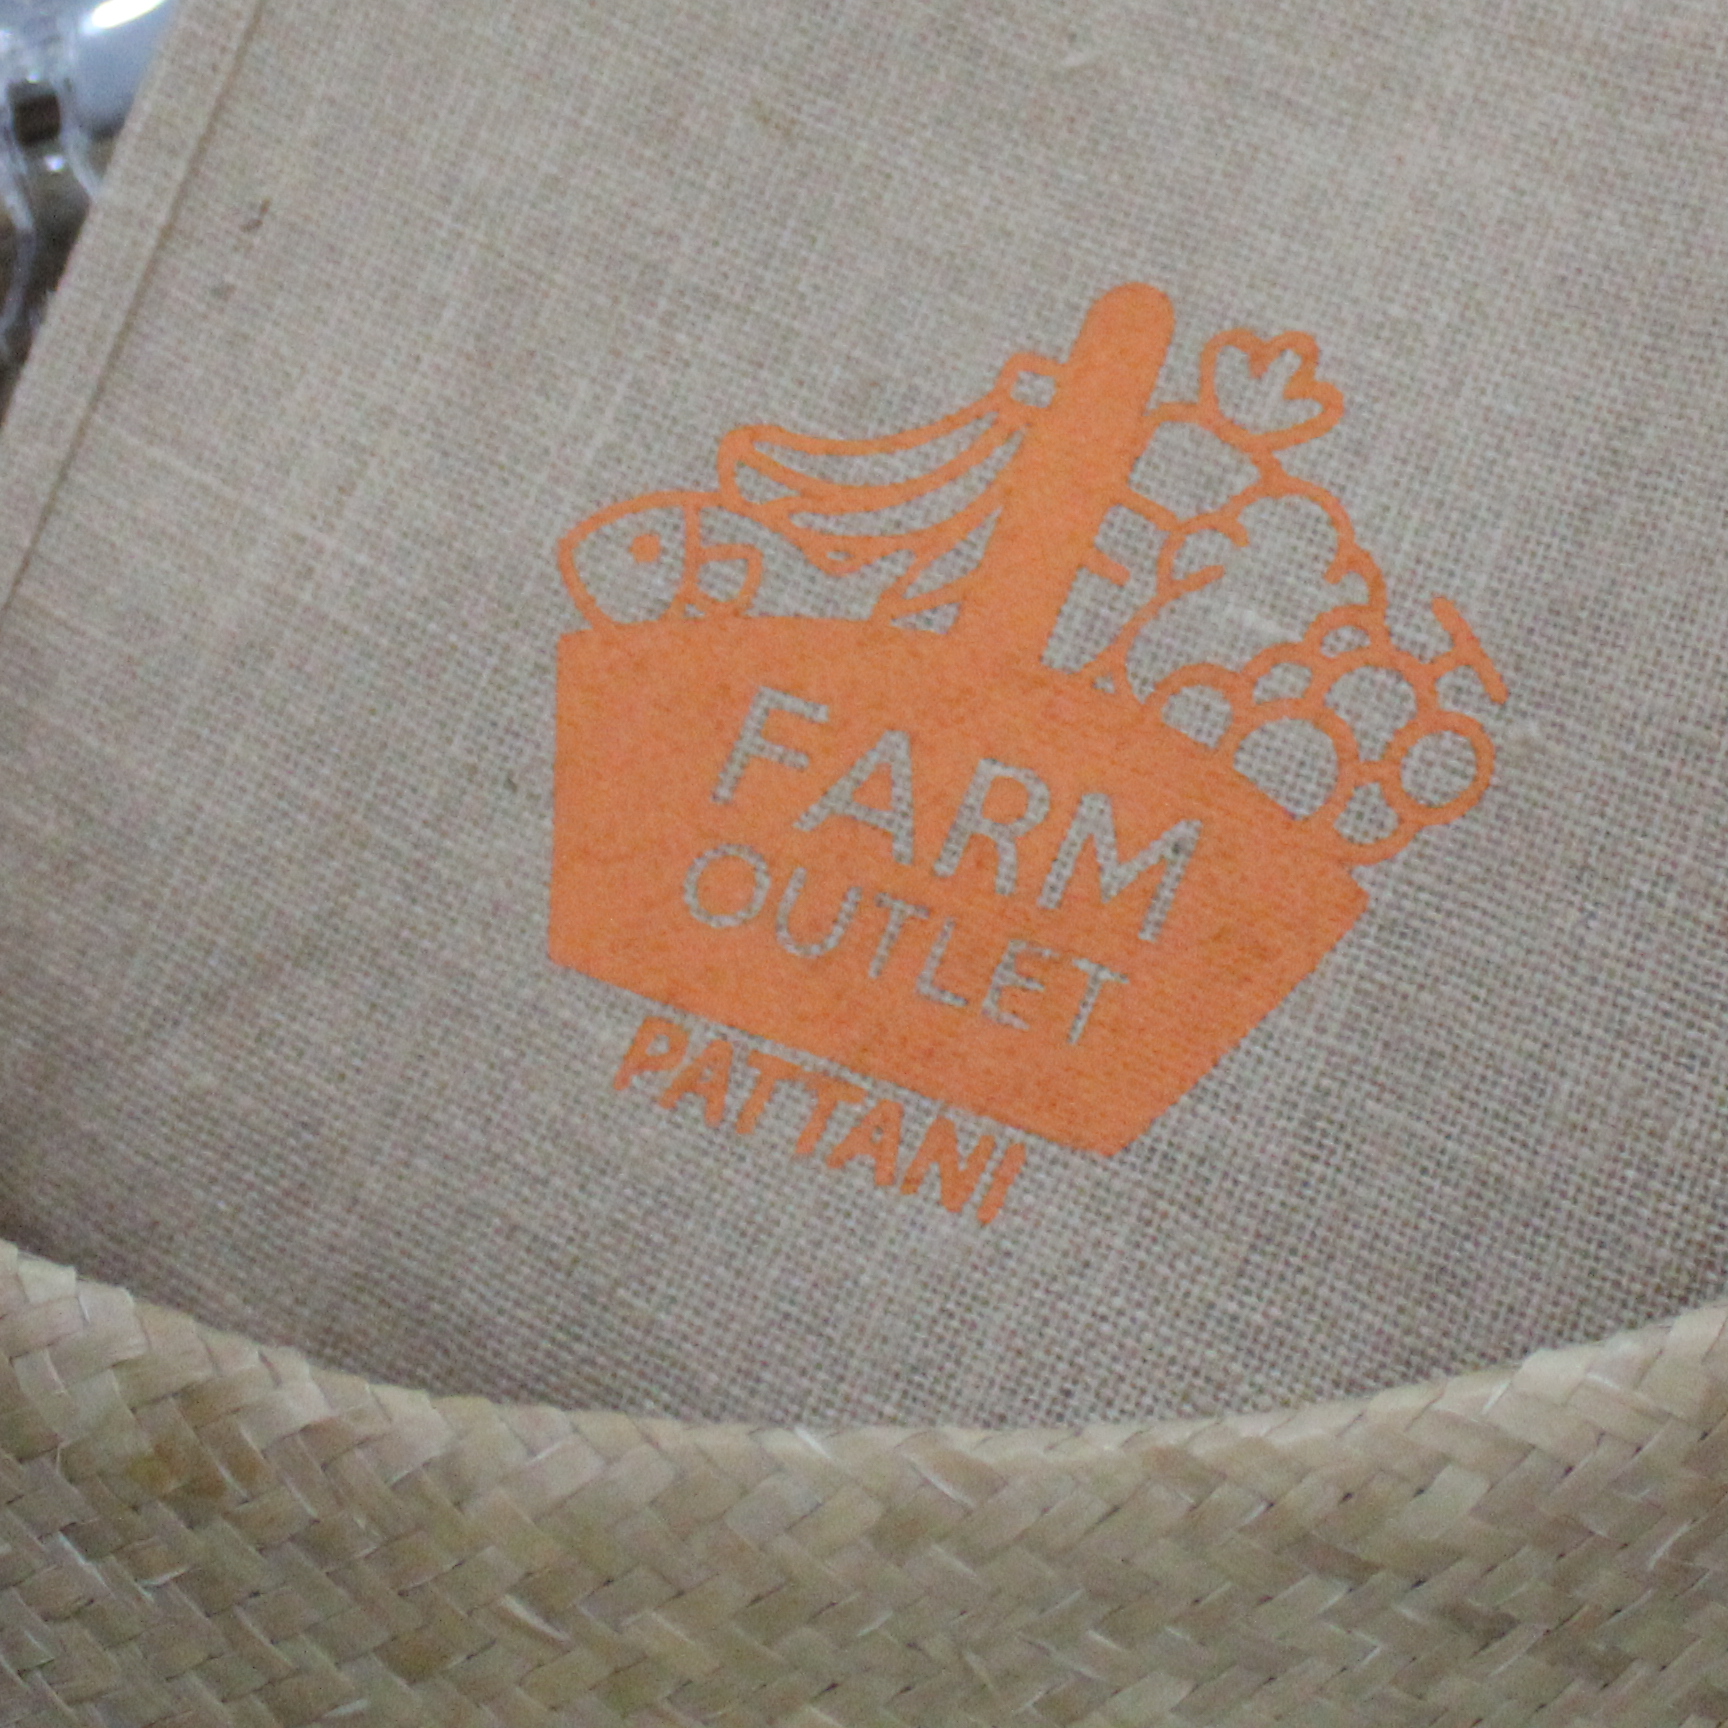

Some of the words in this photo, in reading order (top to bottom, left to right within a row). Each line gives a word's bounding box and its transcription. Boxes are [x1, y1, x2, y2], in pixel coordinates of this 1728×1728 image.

[711, 686, 1203, 942] FARM
[682, 843, 1129, 1045] OUTLET
[613, 1016, 1027, 1225] PATTANI
